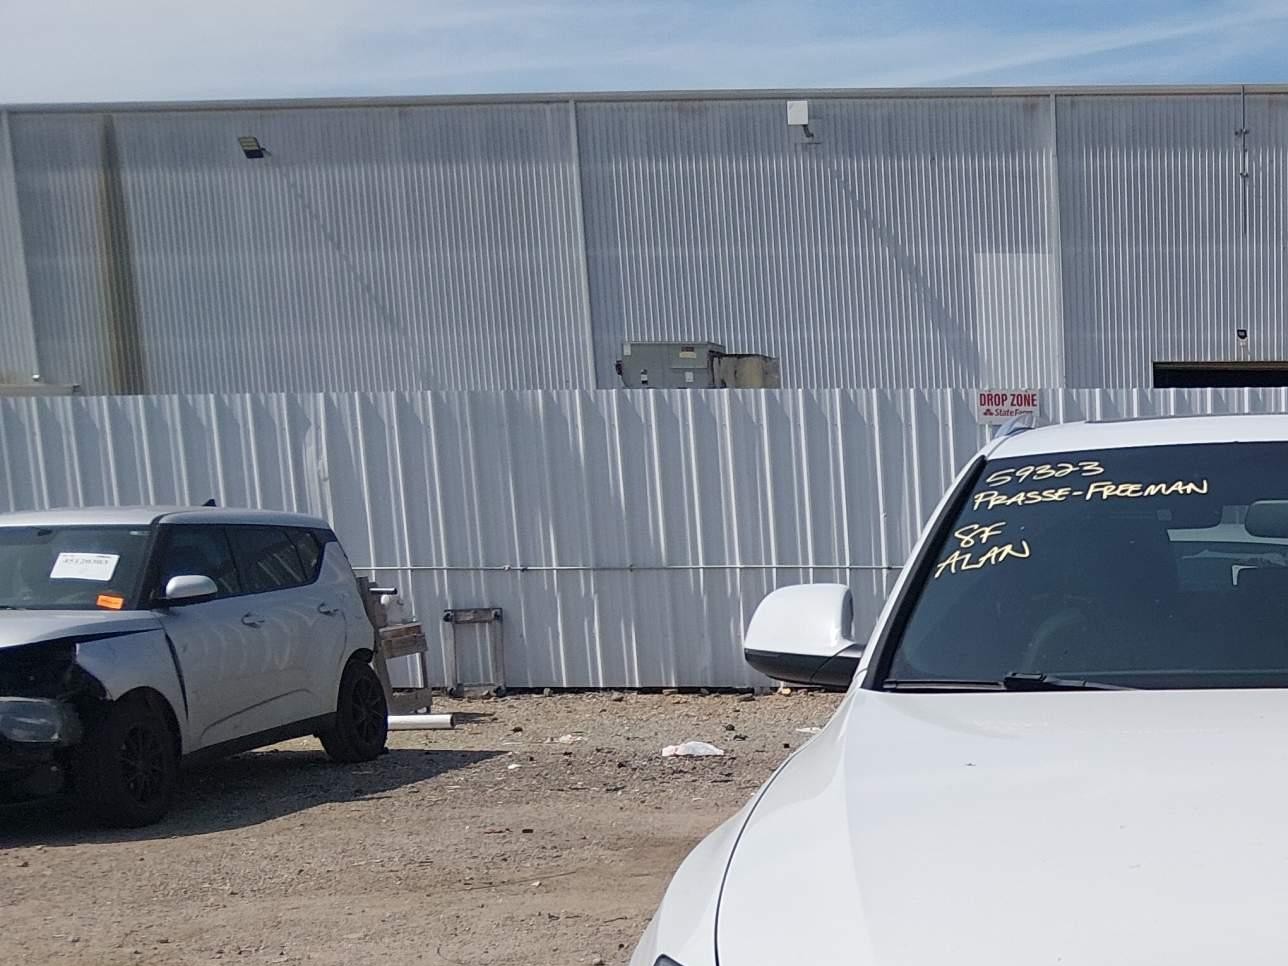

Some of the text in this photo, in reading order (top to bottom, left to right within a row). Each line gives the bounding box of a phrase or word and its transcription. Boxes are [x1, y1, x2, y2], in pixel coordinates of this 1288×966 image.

[979, 393, 1038, 407] DROP ZONE
[986, 461, 1104, 487] 59323
[973, 480, 1208, 511] PRASSE-FREEMAN
[934, 540, 1030, 579] ALAN
